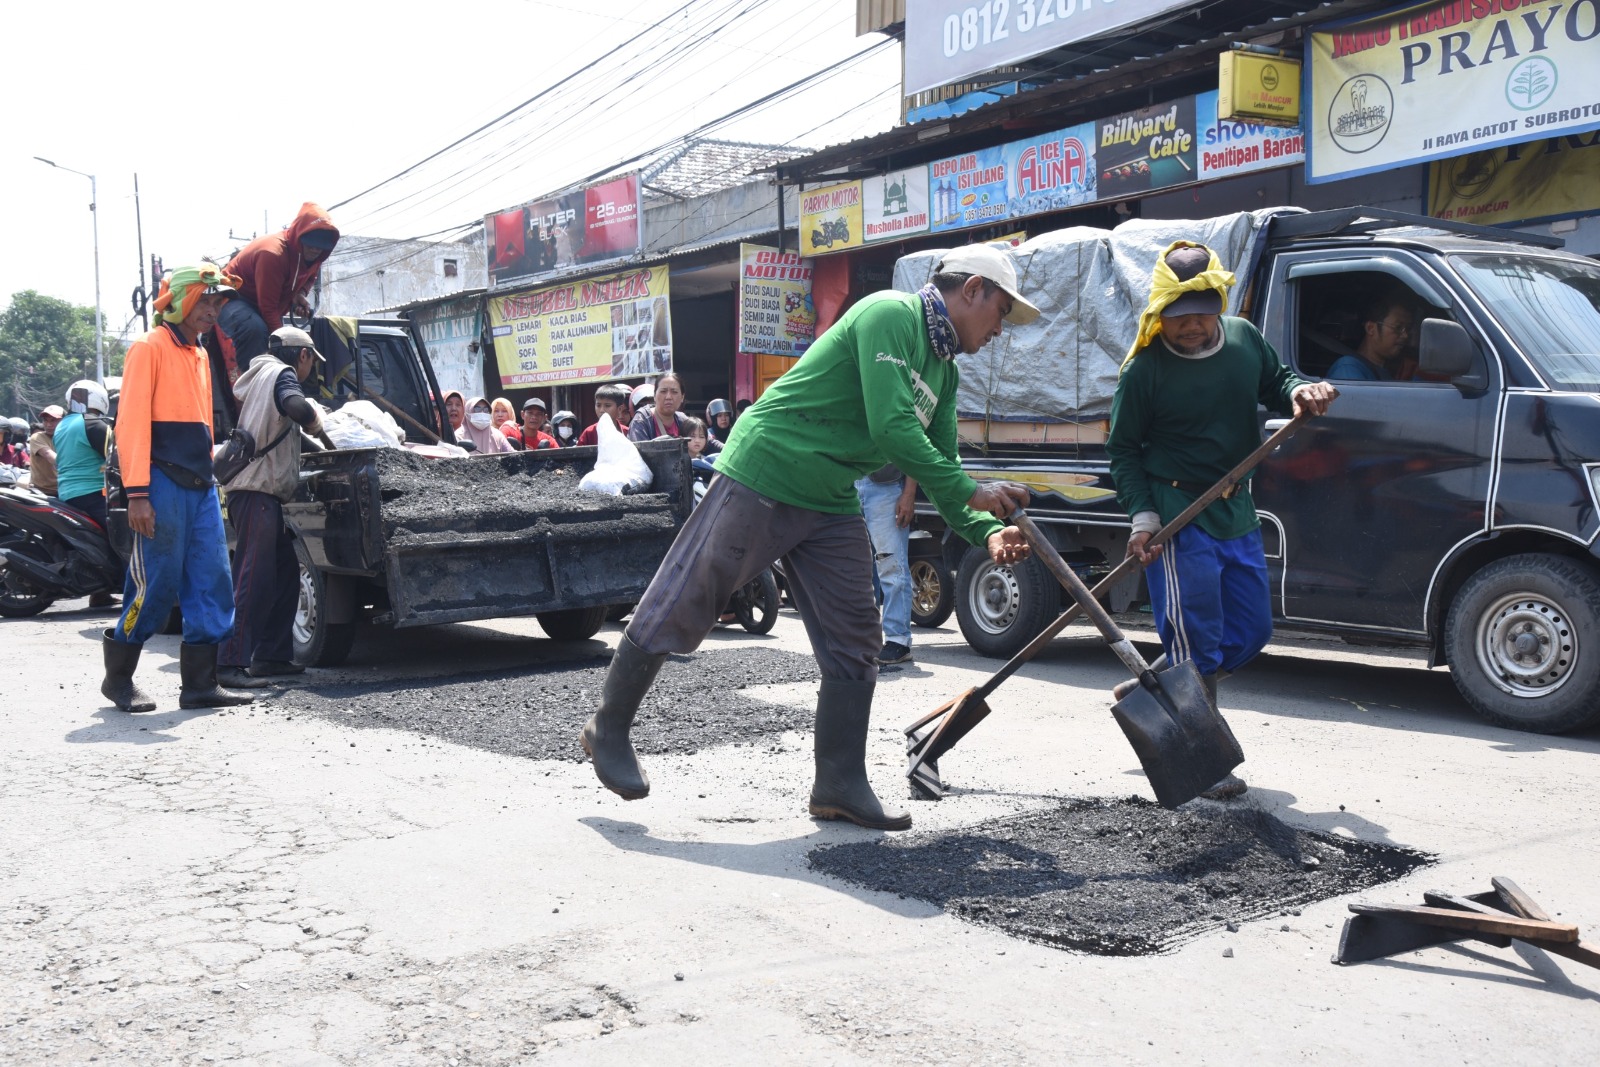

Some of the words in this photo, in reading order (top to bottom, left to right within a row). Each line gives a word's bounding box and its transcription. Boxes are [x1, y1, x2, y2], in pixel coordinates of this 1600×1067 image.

[943, 0, 1009, 58] 0812
[1397, 0, 1545, 41] TRADISI
[1260, 92, 1292, 105] MANCUR
[1101, 105, 1178, 148] Billyard
[1436, 131, 1469, 148] RAYA
[1472, 120, 1518, 140] GATOT
[1524, 103, 1600, 129] SUBROTO
[1040, 142, 1060, 160] ICE
[1149, 128, 1191, 160] Cafe
[933, 158, 957, 178] DEPO
[960, 154, 977, 171] AIR
[1203, 144, 1259, 171] Penitipan
[1017, 137, 1086, 198] ALINA
[958, 174, 971, 189] ISI
[973, 166, 1004, 186] ULANG
[803, 193, 829, 213] PARKIR
[832, 186, 859, 207] MOTOR
[1456, 200, 1509, 218] MANCUR
[529, 208, 576, 231] FILTER
[866, 219, 902, 236] Musholla
[904, 213, 927, 229] ARUM
[756, 251, 803, 265] CUCI
[500, 286, 577, 322] MEUBEL
[579, 270, 653, 308] MALIK
[745, 284, 760, 295] CUCI
[762, 286, 780, 297] SALJU
[744, 298, 760, 309] CUCI
[762, 300, 780, 311] BIASA
[516, 320, 541, 333] LEMARI
[549, 316, 569, 327] KACA
[570, 312, 587, 323] RIAS
[744, 311, 765, 322] SEMIR
[766, 313, 780, 324] BAN
[551, 329, 566, 340] RAK
[567, 323, 608, 337] ALUMINIUM
[744, 324, 757, 335] CAS
[759, 325, 776, 336] ACCU
[517, 334, 538, 345] KURSI
[552, 342, 573, 354] DIPAN
[744, 337, 770, 350] TAMBAH
[772, 340, 792, 351] ANGIN
[518, 348, 537, 358] SOFA
[552, 356, 574, 368] BUFET
